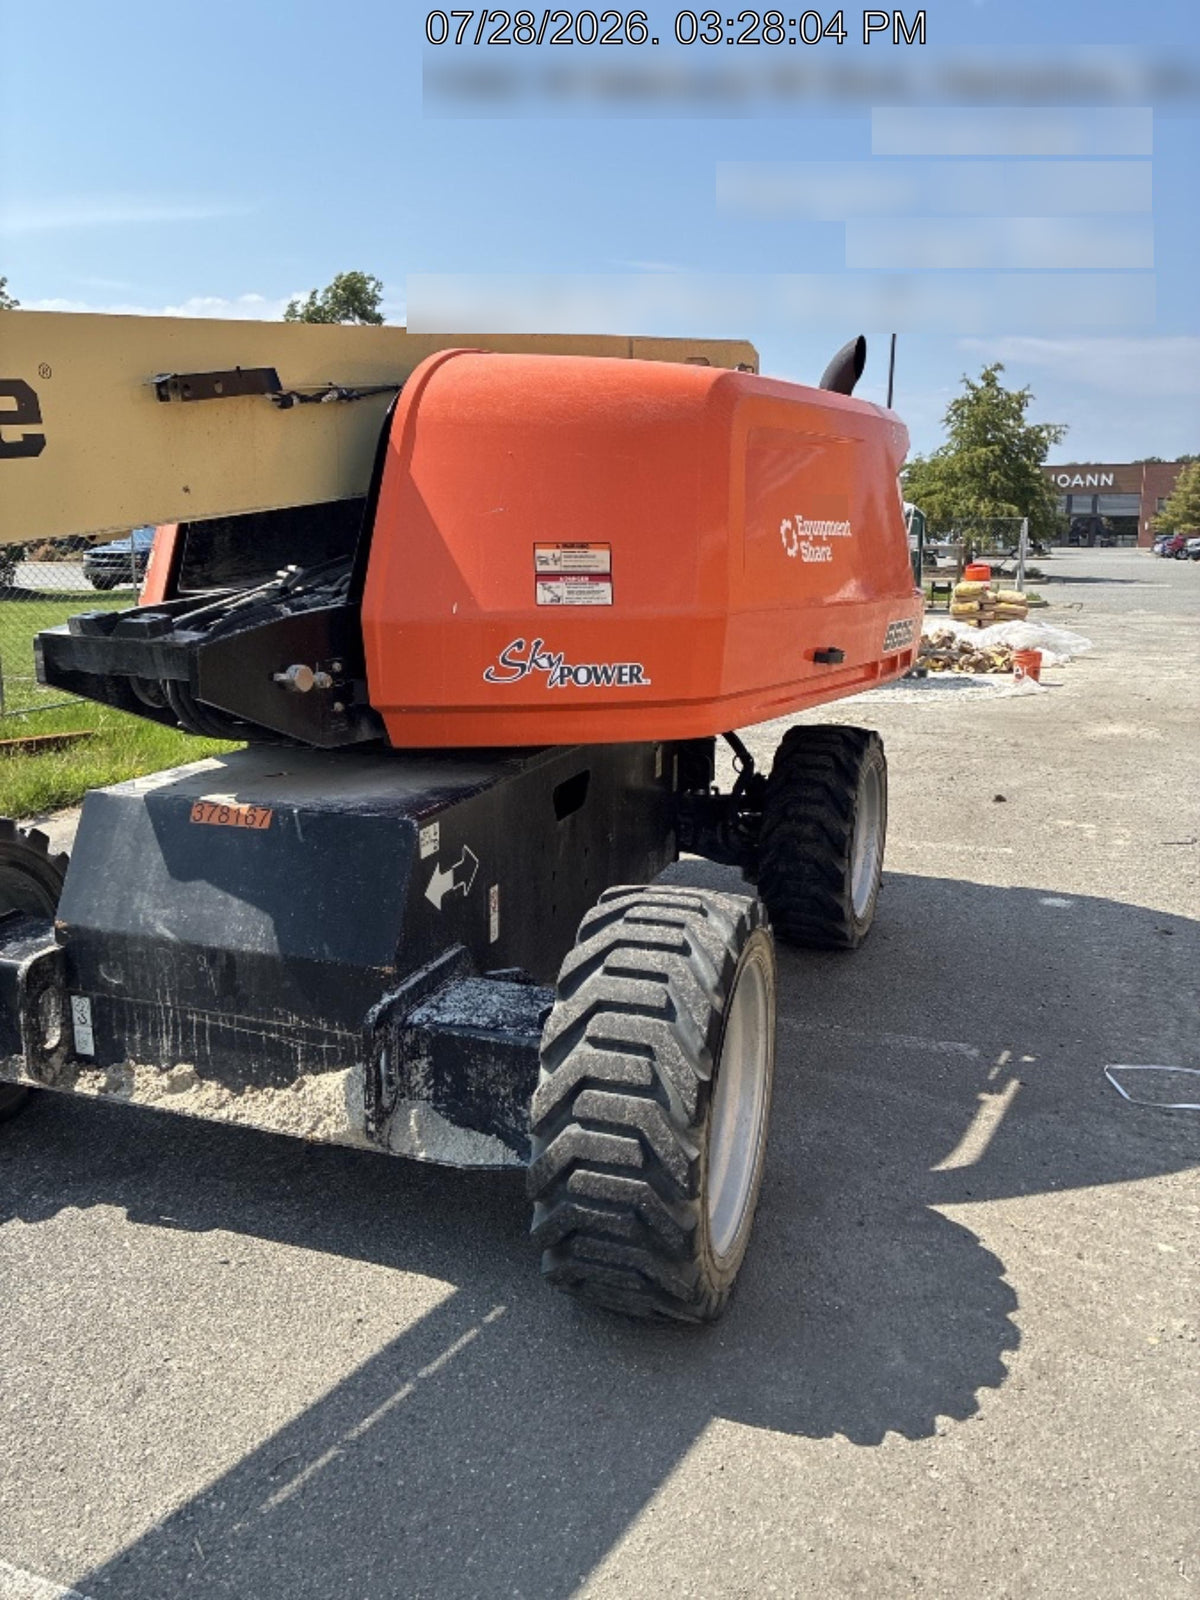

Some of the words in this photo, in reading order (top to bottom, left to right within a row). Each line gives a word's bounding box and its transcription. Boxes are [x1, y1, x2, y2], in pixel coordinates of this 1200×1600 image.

[794, 514, 852, 541] Equipment
[799, 540, 833, 563] Share
[557, 663, 646, 687] POWER
[191, 802, 272, 828] 378167
